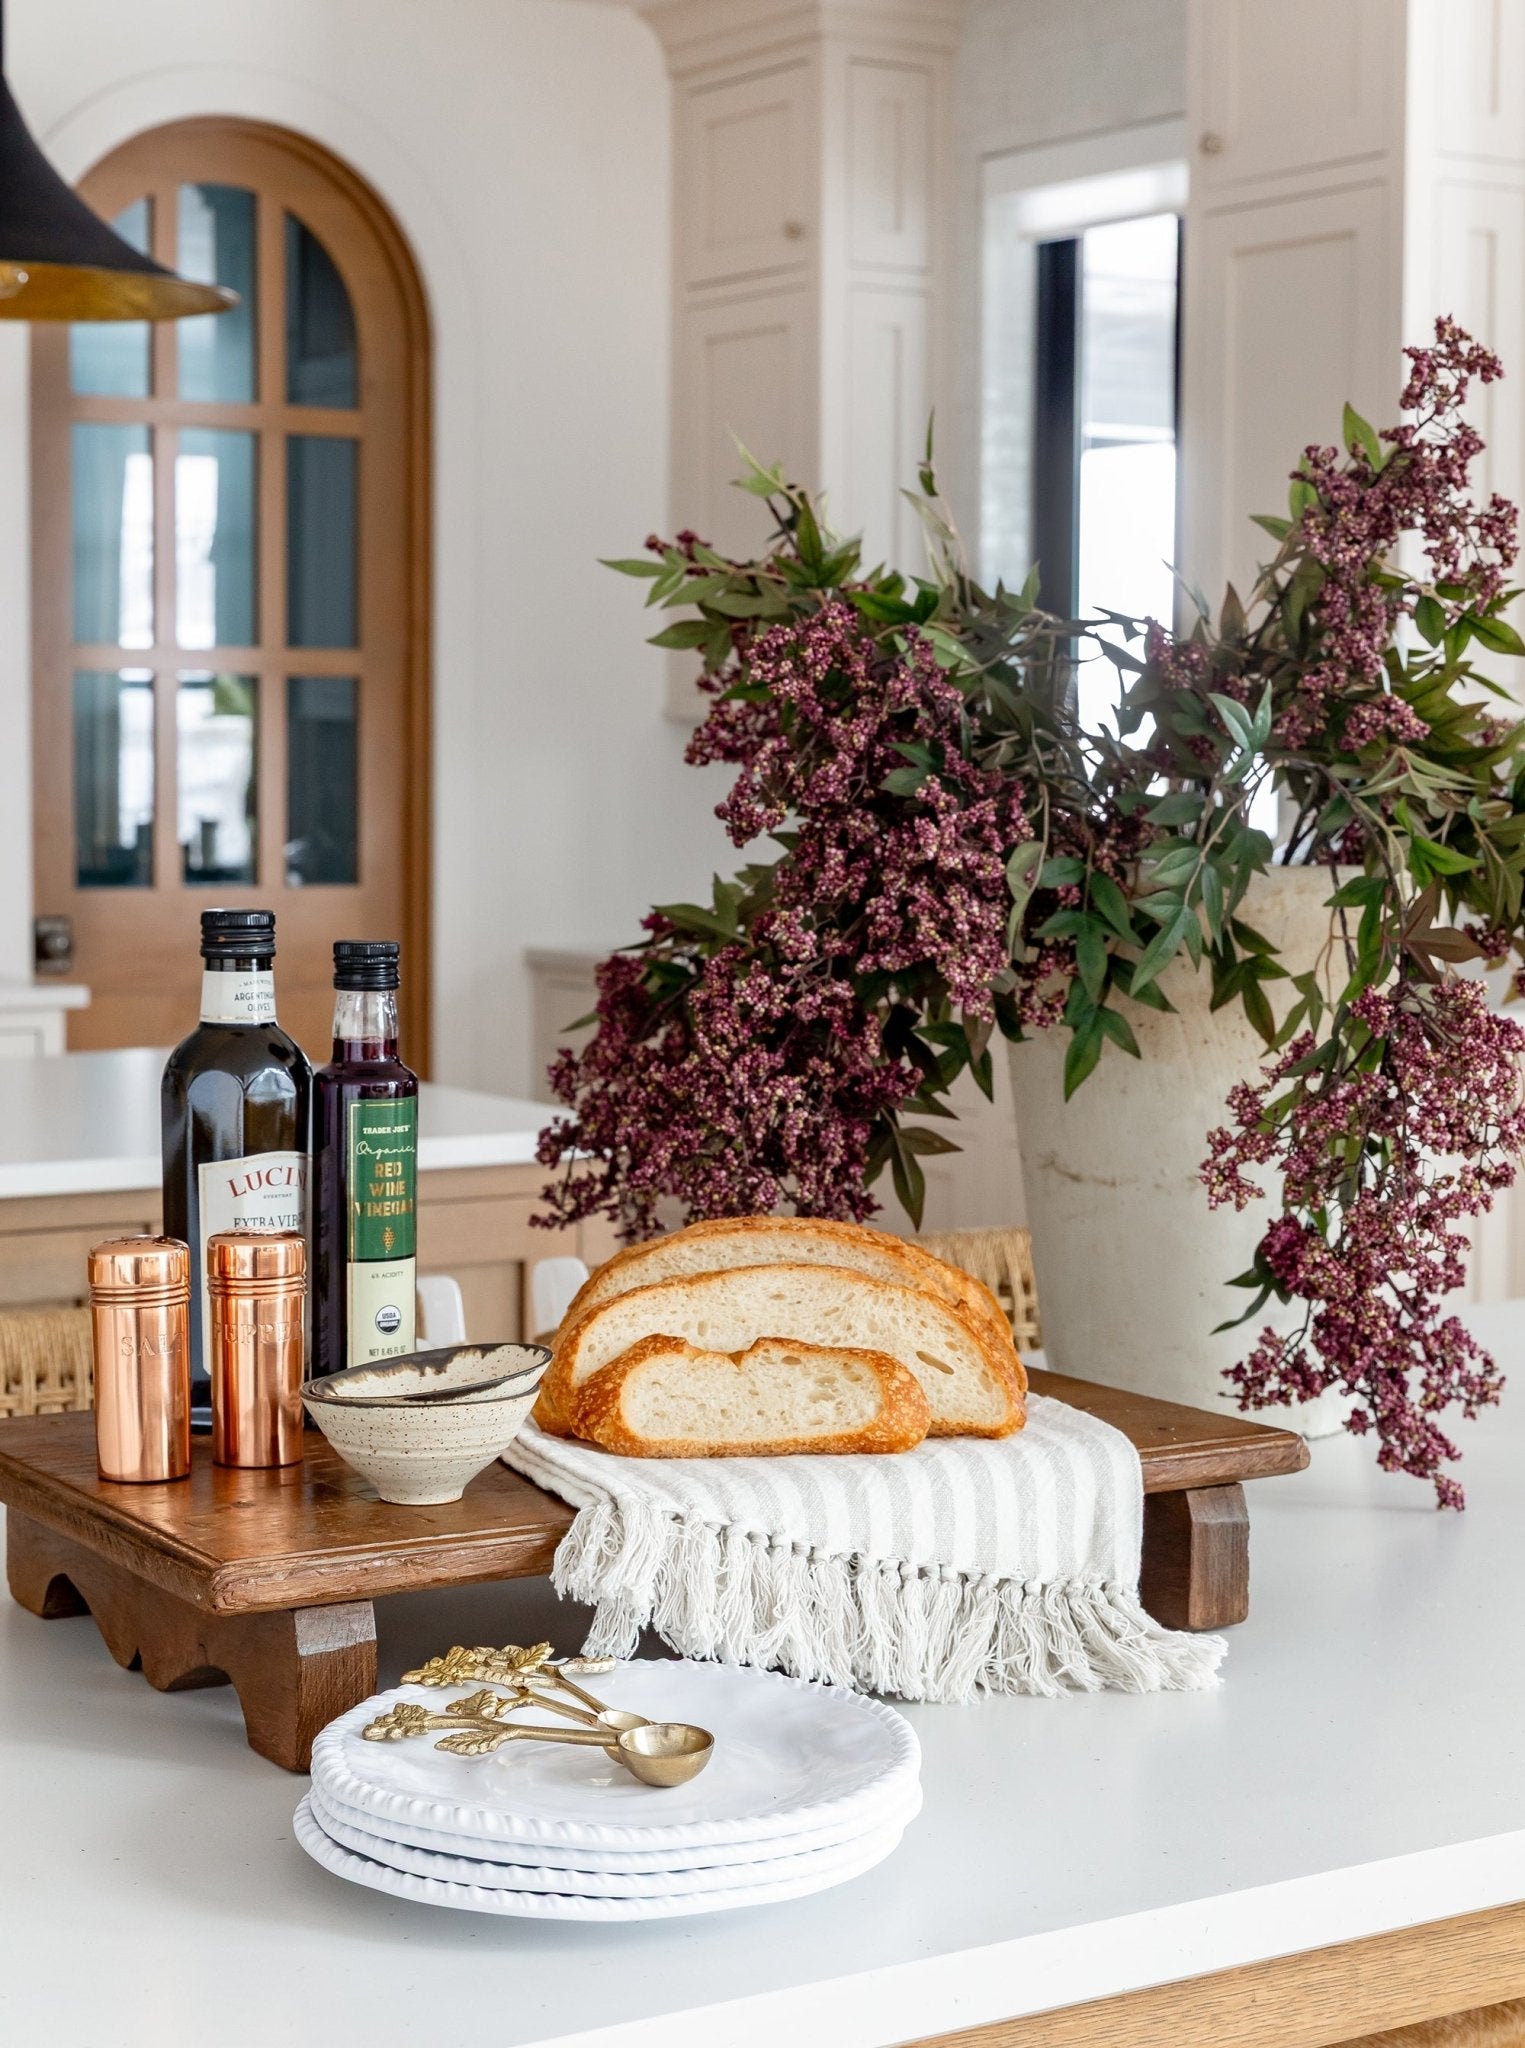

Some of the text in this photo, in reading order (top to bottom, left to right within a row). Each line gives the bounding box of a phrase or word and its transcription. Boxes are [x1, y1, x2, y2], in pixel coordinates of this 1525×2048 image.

[362, 1126, 391, 1134] TRADER
[356, 1140, 415, 1160] Organic
[375, 1162, 402, 1178] RED
[369, 1181, 406, 1197] WINE
[121, 1331, 184, 1357] SALT
[368, 1348, 380, 1357] NET
